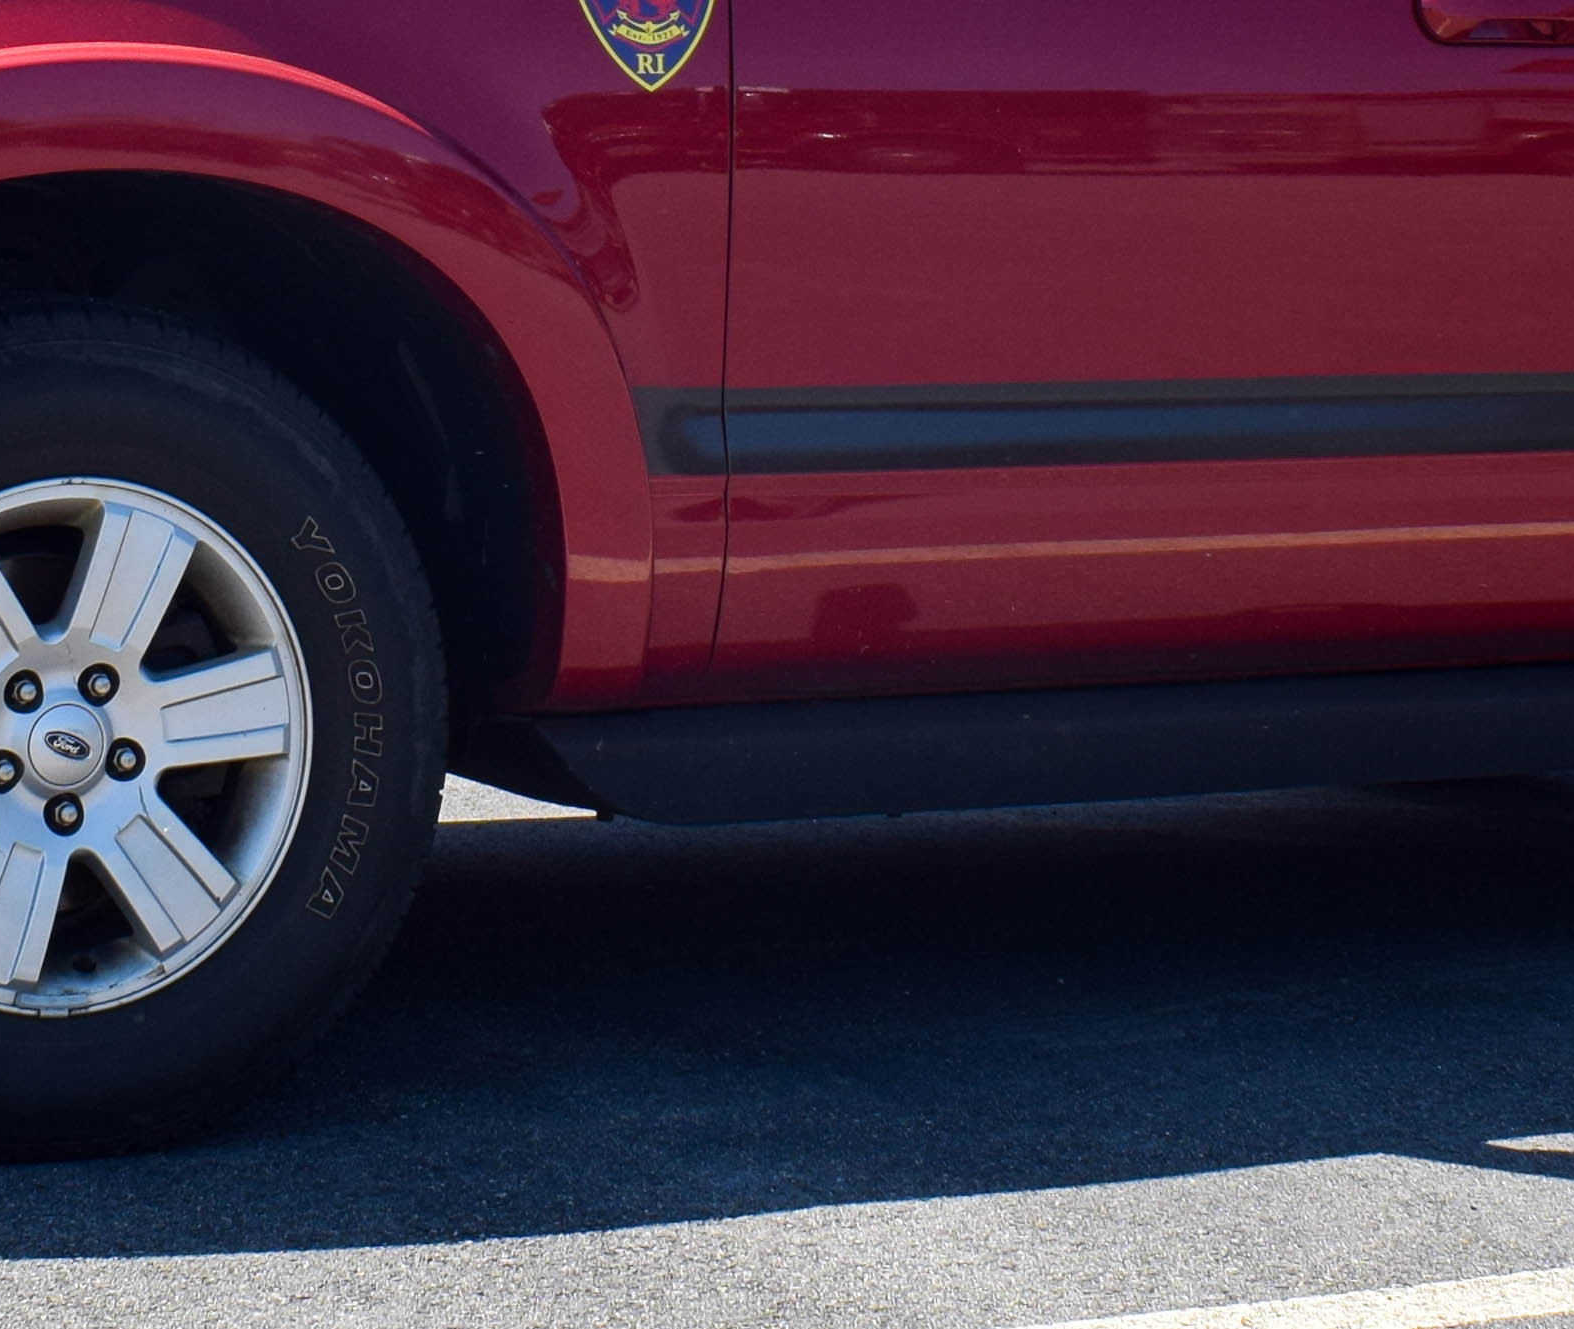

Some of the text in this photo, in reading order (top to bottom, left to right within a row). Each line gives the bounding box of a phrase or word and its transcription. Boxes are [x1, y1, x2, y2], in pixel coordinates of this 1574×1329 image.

[636, 53, 665, 74] RI
[290, 516, 384, 920] YOKOHAMA
[52, 735, 81, 755] Ford
